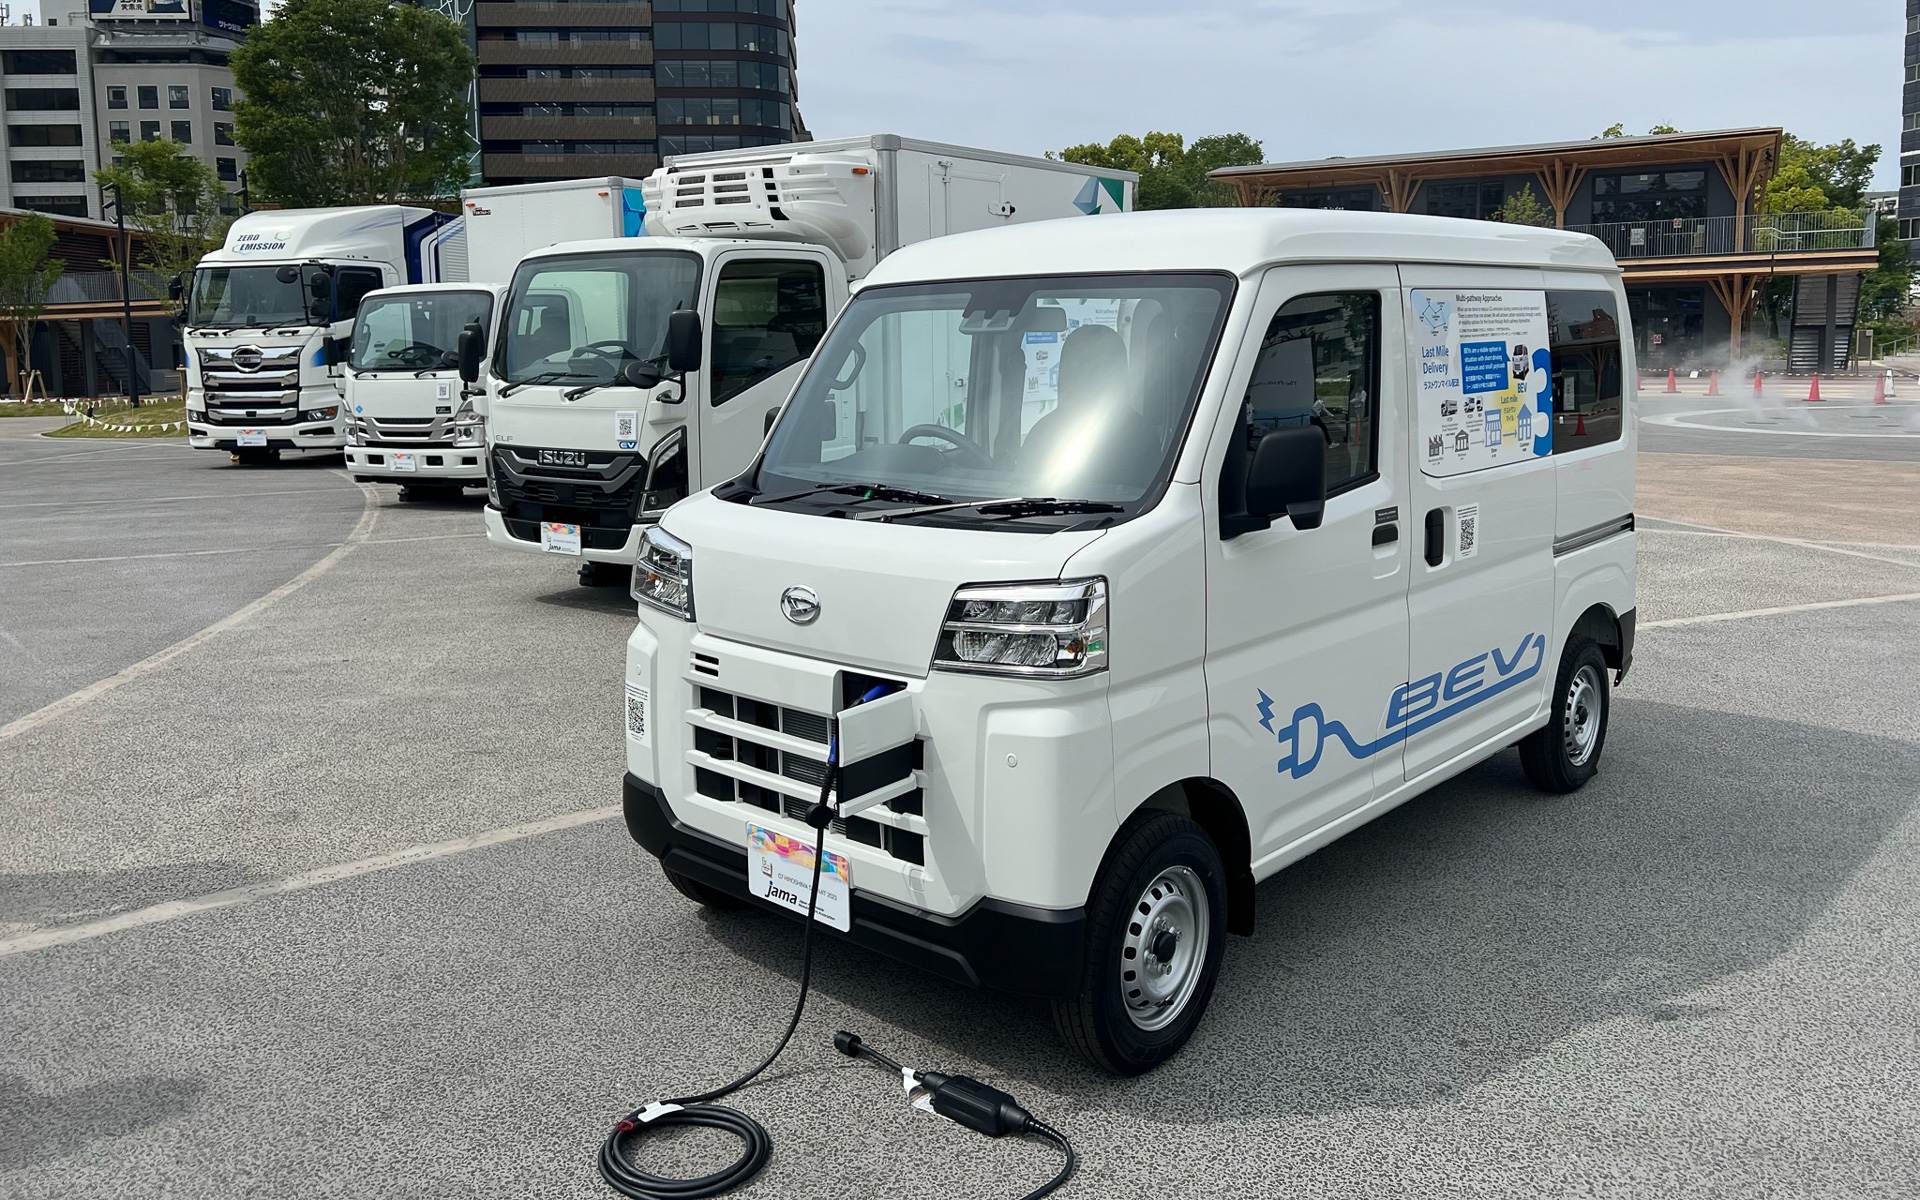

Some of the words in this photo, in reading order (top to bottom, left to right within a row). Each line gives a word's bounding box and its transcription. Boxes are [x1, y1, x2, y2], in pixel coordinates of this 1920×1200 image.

[237, 234, 260, 242] ZERO
[240, 242, 286, 251] EMISSION
[1421, 346, 1435, 358] Last
[1435, 345, 1449, 357] Mile
[1423, 362, 1449, 375] Delivery
[1517, 382, 1527, 393] BEV
[620, 441, 635, 449] EV
[538, 450, 585, 466] ISUZU
[1385, 632, 1535, 729] BEV
[784, 876, 809, 889] HIROSHIMA
[764, 880, 798, 905] jama
